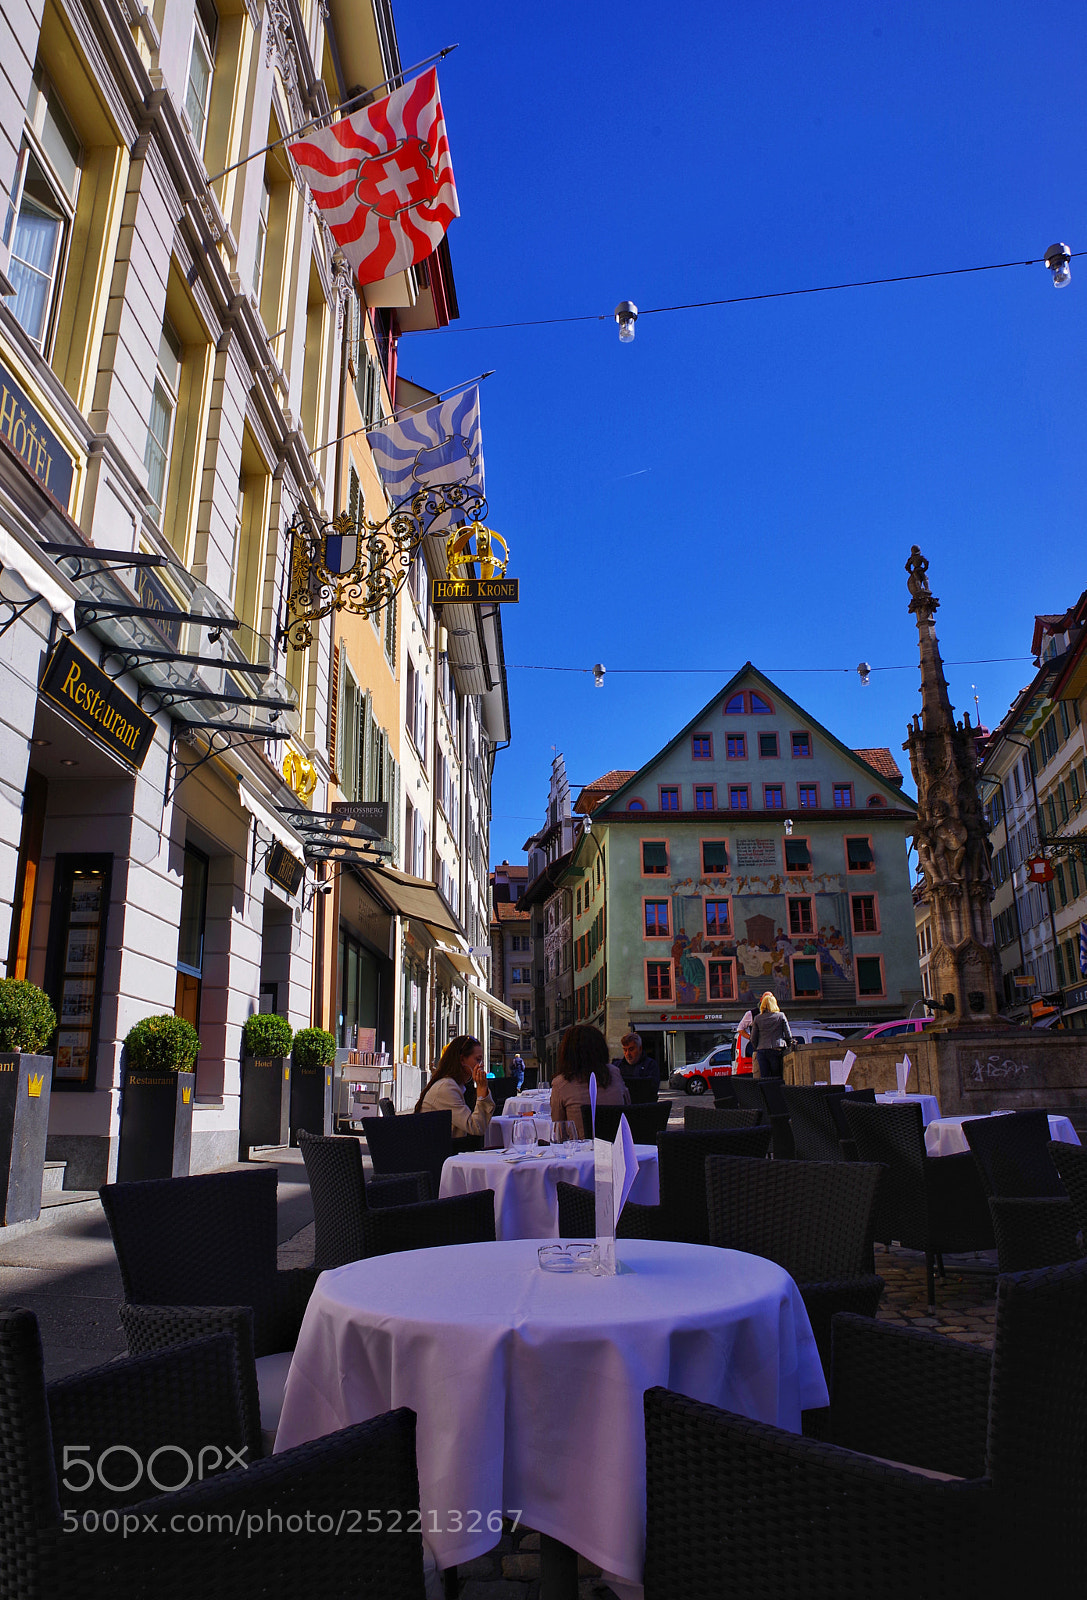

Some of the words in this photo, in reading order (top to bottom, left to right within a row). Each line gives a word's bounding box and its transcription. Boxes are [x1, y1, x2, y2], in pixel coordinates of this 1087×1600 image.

[477, 581, 515, 597] KRONE
[60, 660, 141, 750] Restaurant
[335, 806, 384, 814] SCHLOSSBERG
[254, 1060, 273, 1068] Hotel
[129, 1075, 174, 1085] Restaurant
